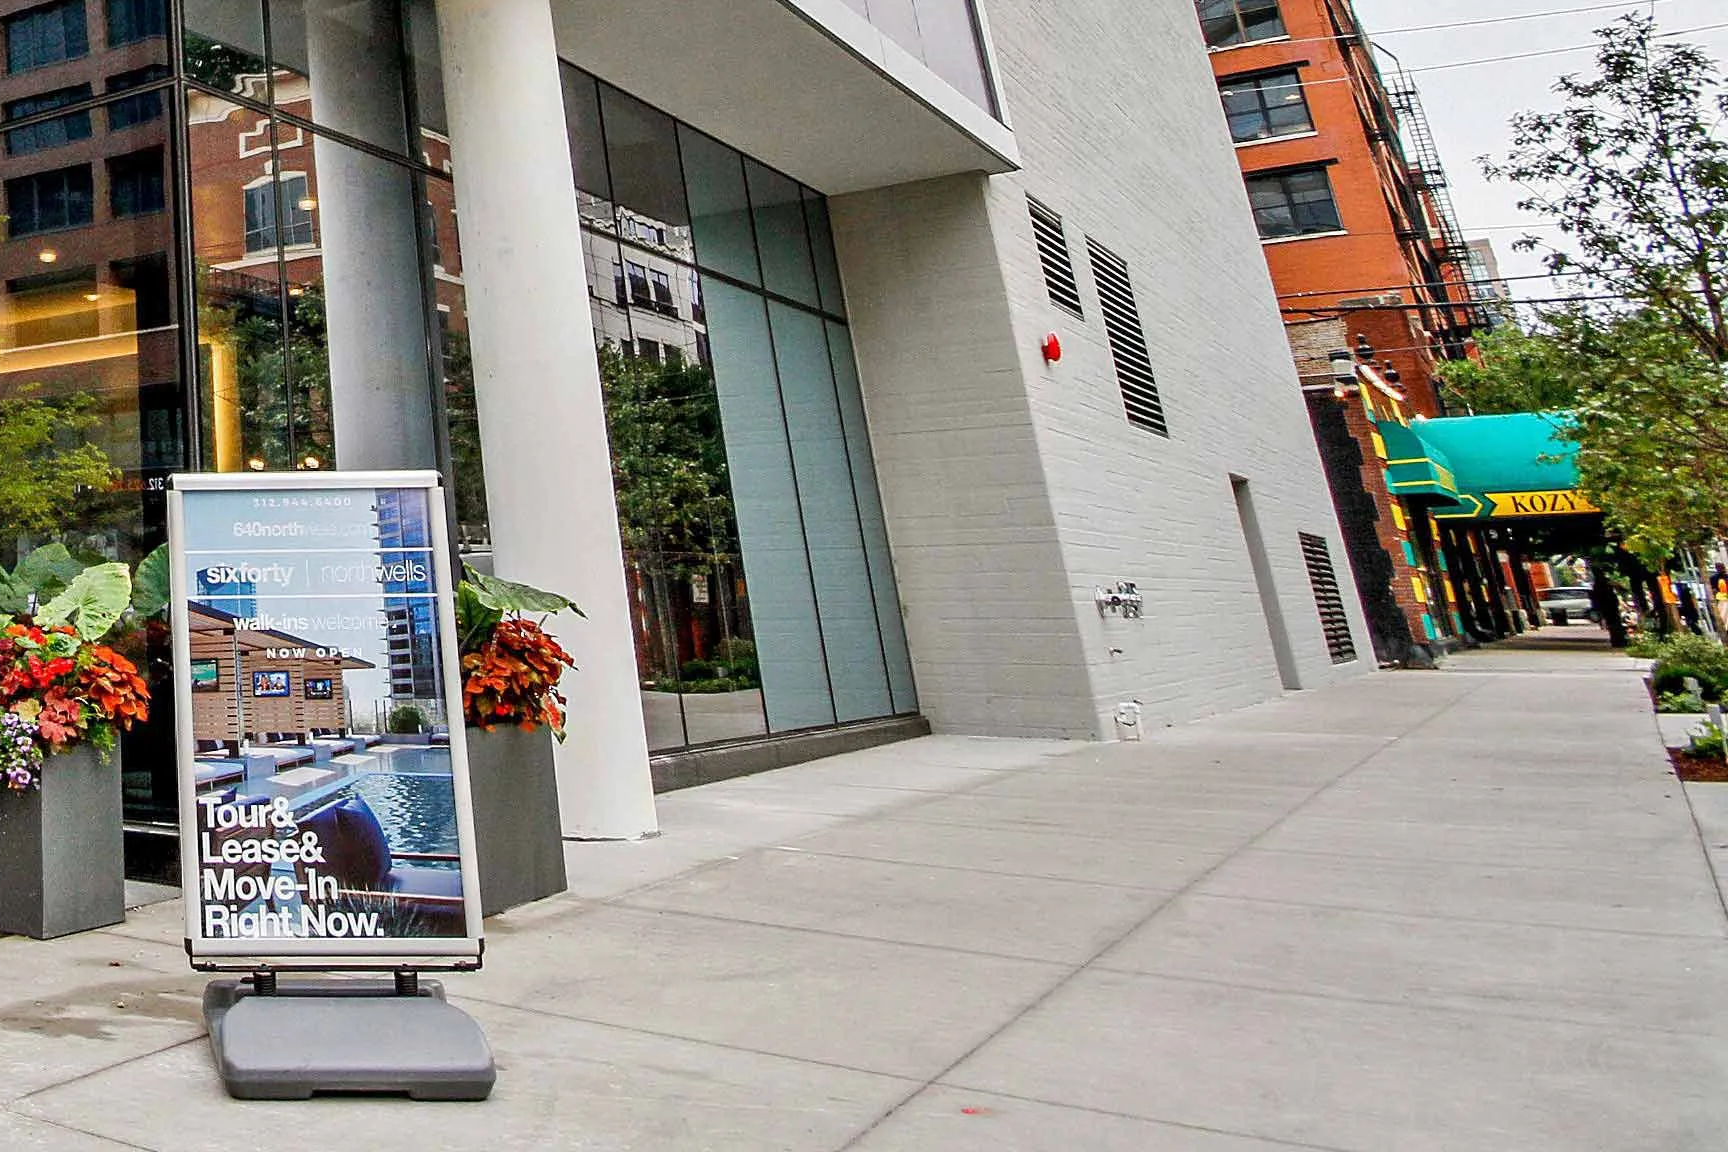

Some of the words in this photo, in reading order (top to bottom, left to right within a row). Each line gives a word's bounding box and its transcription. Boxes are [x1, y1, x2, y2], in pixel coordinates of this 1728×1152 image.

[233, 521, 377, 538] 640north.com
[206, 560, 295, 586] sixforty
[233, 614, 309, 631] walk-ins
[266, 648, 306, 659] NOW
[315, 647, 363, 658] OPEN
[198, 796, 297, 829] Tour&
[202, 831, 326, 864] Lease&
[203, 867, 339, 901] Move-In
[204, 904, 293, 938] Right
[300, 904, 385, 937] Now.
